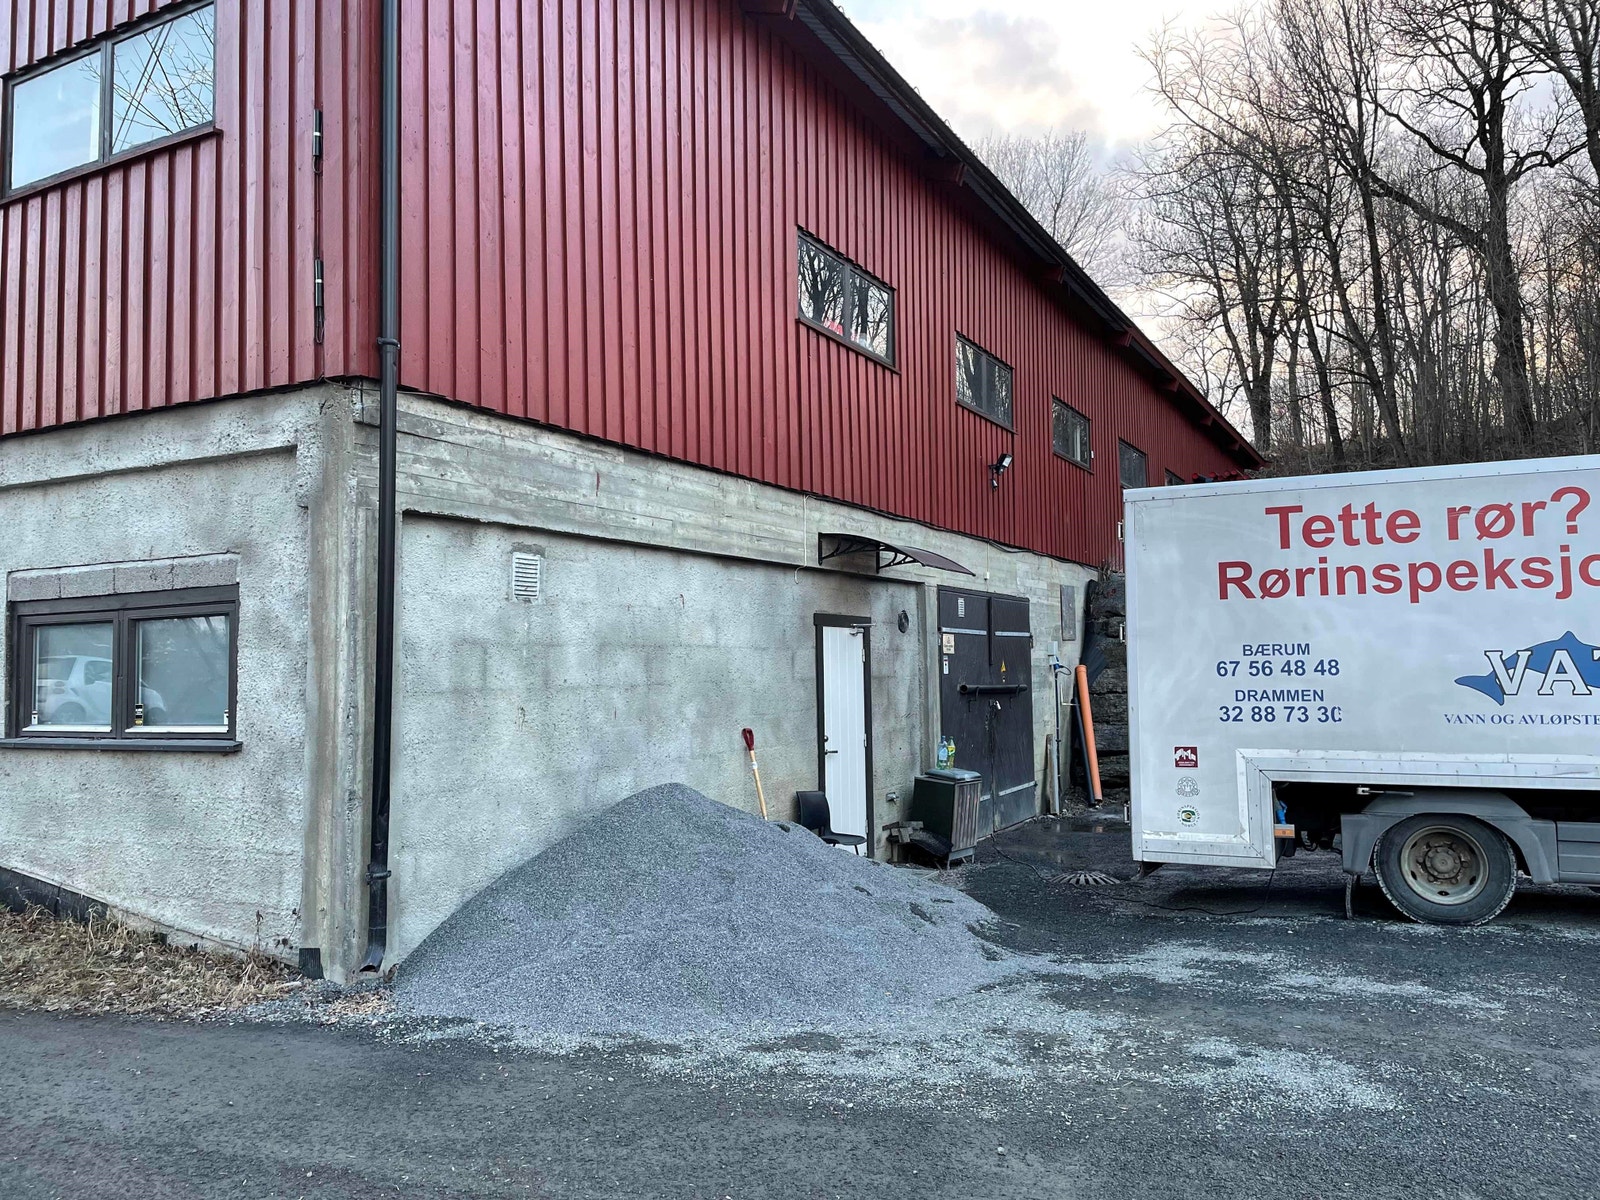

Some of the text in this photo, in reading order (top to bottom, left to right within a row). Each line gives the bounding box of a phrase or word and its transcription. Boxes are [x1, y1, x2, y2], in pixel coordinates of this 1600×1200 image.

[1264, 486, 1592, 550] Tette rør?
[1242, 643, 1311, 657] BÆRUM
[1216, 659, 1340, 677] 67 56 48 48
[1484, 648, 1600, 696] VA
[1235, 689, 1325, 702] DRAMMEN
[1219, 705, 1342, 723] 32 88 73 30
[1443, 713, 1486, 724] VANN
[1490, 713, 1514, 725] OG
